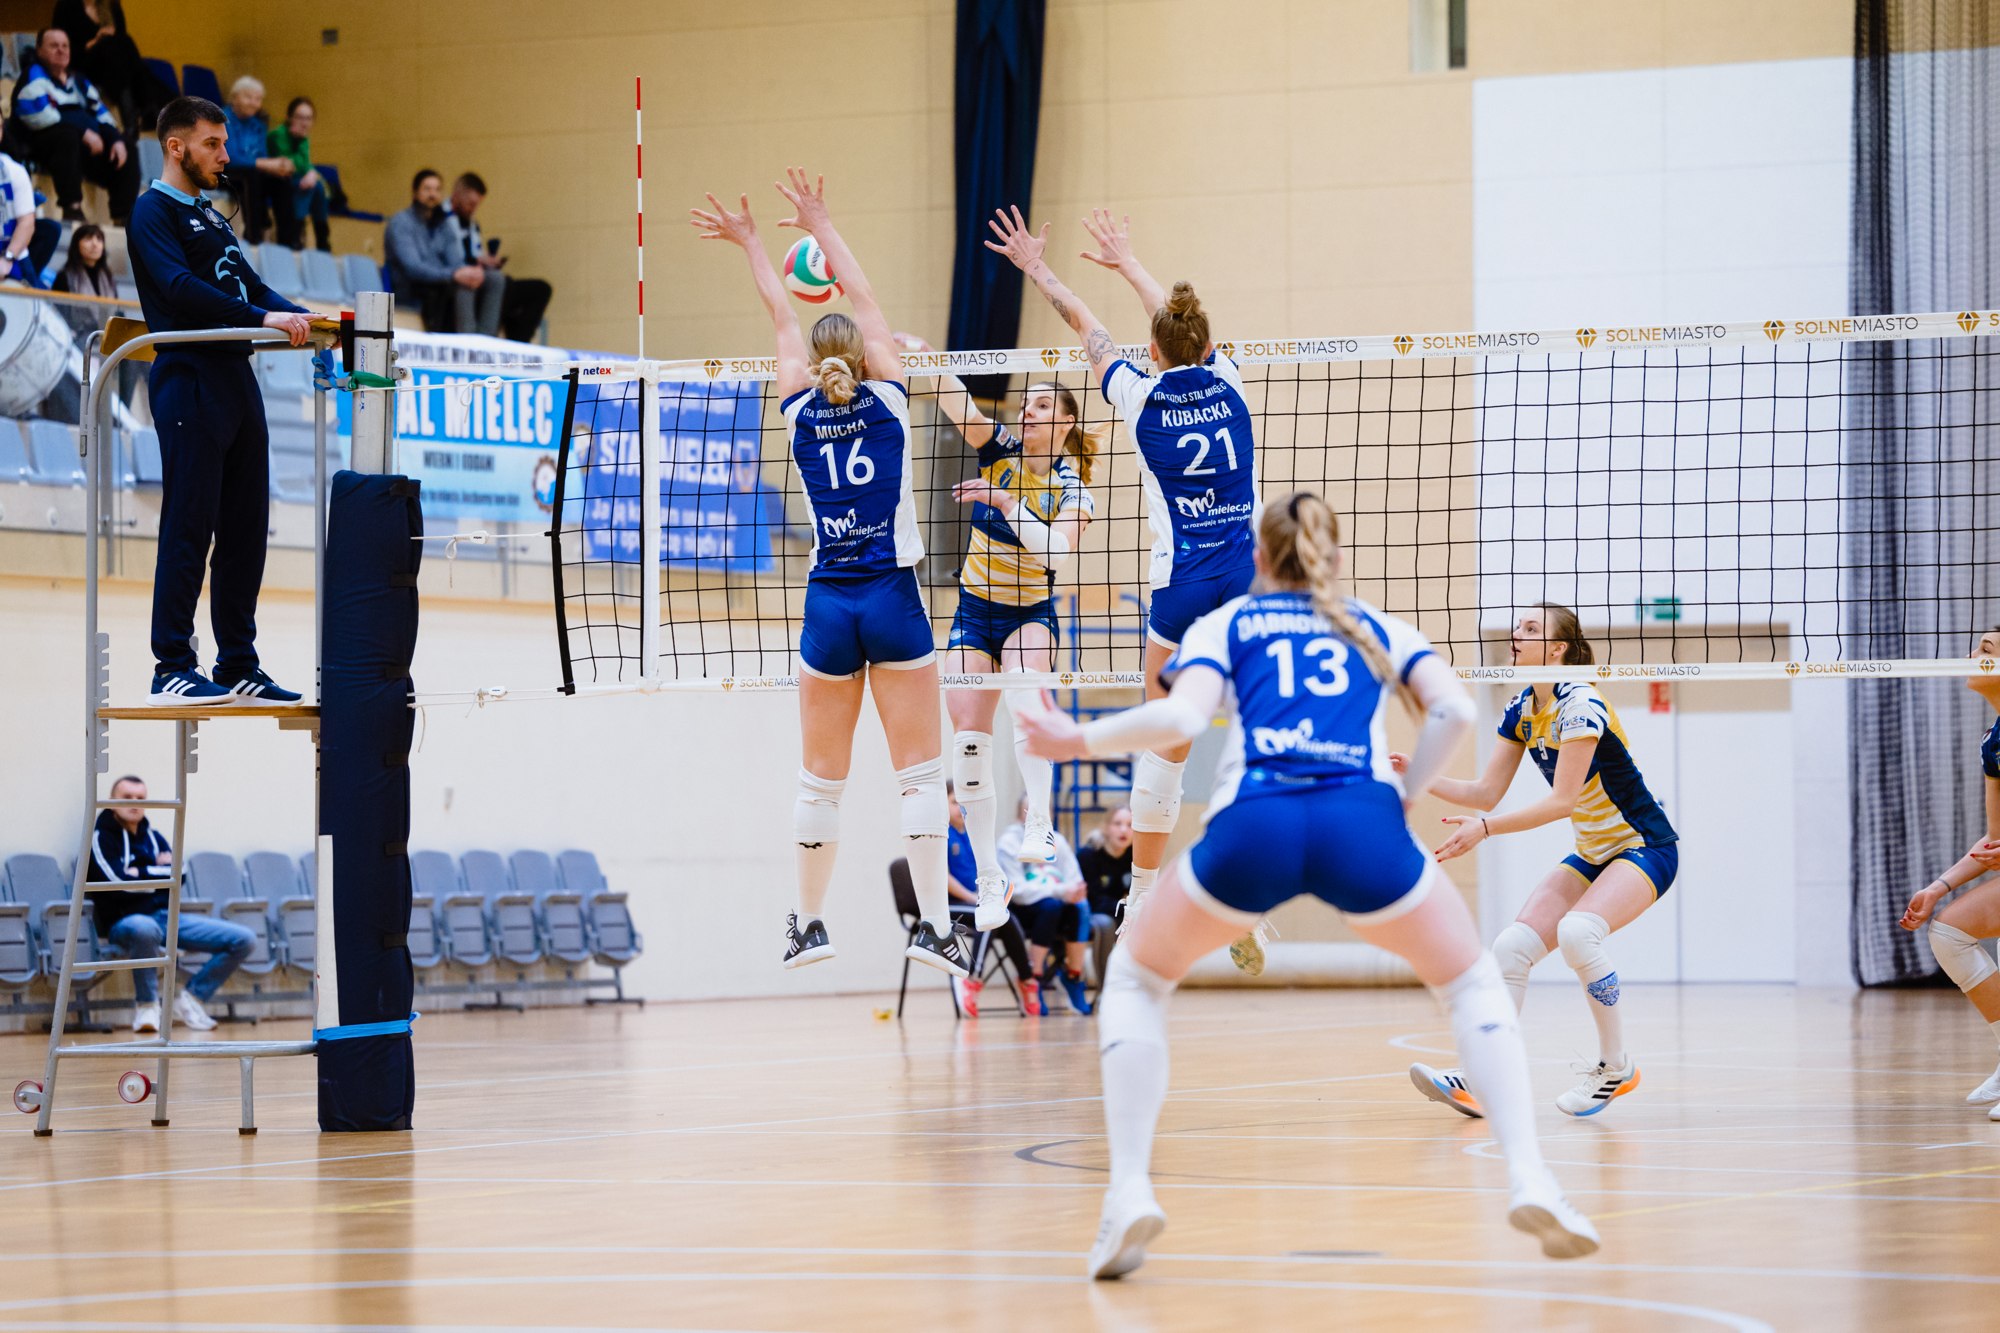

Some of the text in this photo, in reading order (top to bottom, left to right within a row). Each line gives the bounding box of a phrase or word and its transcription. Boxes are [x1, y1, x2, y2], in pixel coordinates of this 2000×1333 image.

[1606, 325, 1726, 342] SOLNEMIASTO
[1795, 317, 1918, 334] SOLNEMIASTO
[1243, 340, 1358, 356] SOLNEMIASTO
[1423, 333, 1540, 349] SOLNEMIASTO
[731, 361, 777, 373] SOLNE
[900, 352, 1008, 368] SOLNEMIASTO
[583, 367, 612, 376] netex
[1154, 391, 1166, 400] ITA
[1188, 389, 1205, 401] STAL
[397, 368, 435, 436] AL
[444, 376, 553, 446] MIELEC
[803, 408, 815, 418] ITA
[835, 406, 851, 416] STAL
[1161, 400, 1233, 428] KUBACKA
[815, 419, 868, 439] MUCHA
[600, 426, 733, 487] STA MIELEC
[1176, 427, 1238, 476] 21
[819, 437, 875, 490] 16
[1208, 501, 1251, 516] mielec.pl
[1266, 637, 1350, 698] 13
[1456, 668, 1514, 679] NEMIASTO
[1617, 666, 1700, 676] SOLNEMIASTO
[1806, 662, 1892, 673] SOLNEMIASTO
[740, 677, 800, 688] SOLNEMIAS
[939, 676, 983, 685] EMIASTO
